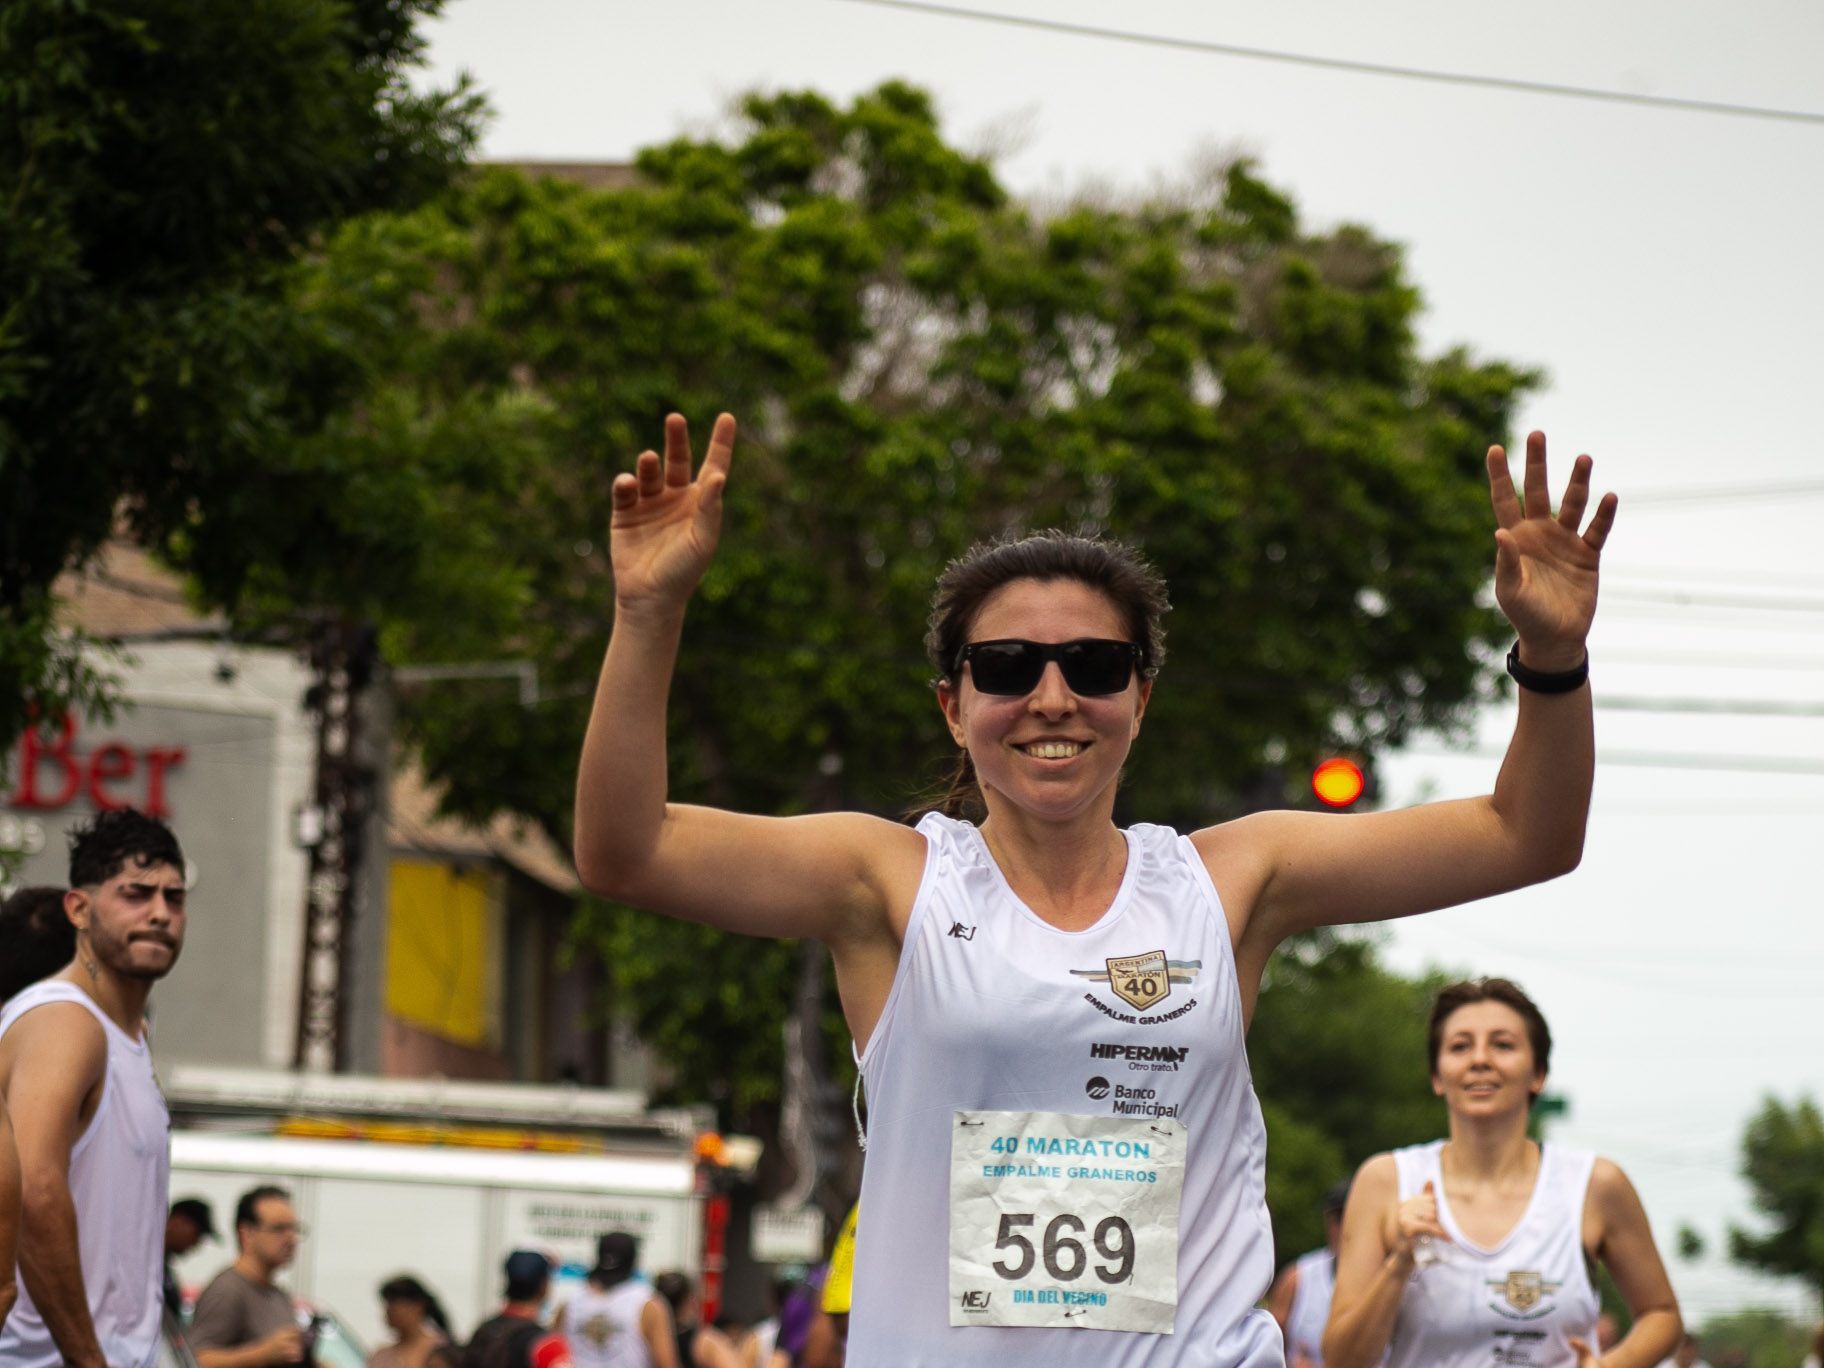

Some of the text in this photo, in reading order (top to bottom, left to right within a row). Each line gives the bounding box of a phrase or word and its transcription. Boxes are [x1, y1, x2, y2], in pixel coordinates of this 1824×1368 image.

[10, 702, 188, 819] Ber
[1114, 955, 1158, 967] ARGENTINA
[1124, 978, 1158, 997] 40
[1084, 993, 1197, 1025] EMPALME GRANEROS
[1128, 1062, 1149, 1071] Otro
[1114, 1085, 1156, 1100] Banco
[1112, 1100, 1178, 1119] Municipal
[990, 1137, 1150, 1159] 40 MARATON
[983, 1165, 1157, 1183] EMPALME GRANEROS
[992, 1213, 1136, 1285] 569
[961, 1291, 991, 1308] NEJ
[1013, 1290, 1034, 1304] DIA
[1038, 1290, 1060, 1305] DEL
